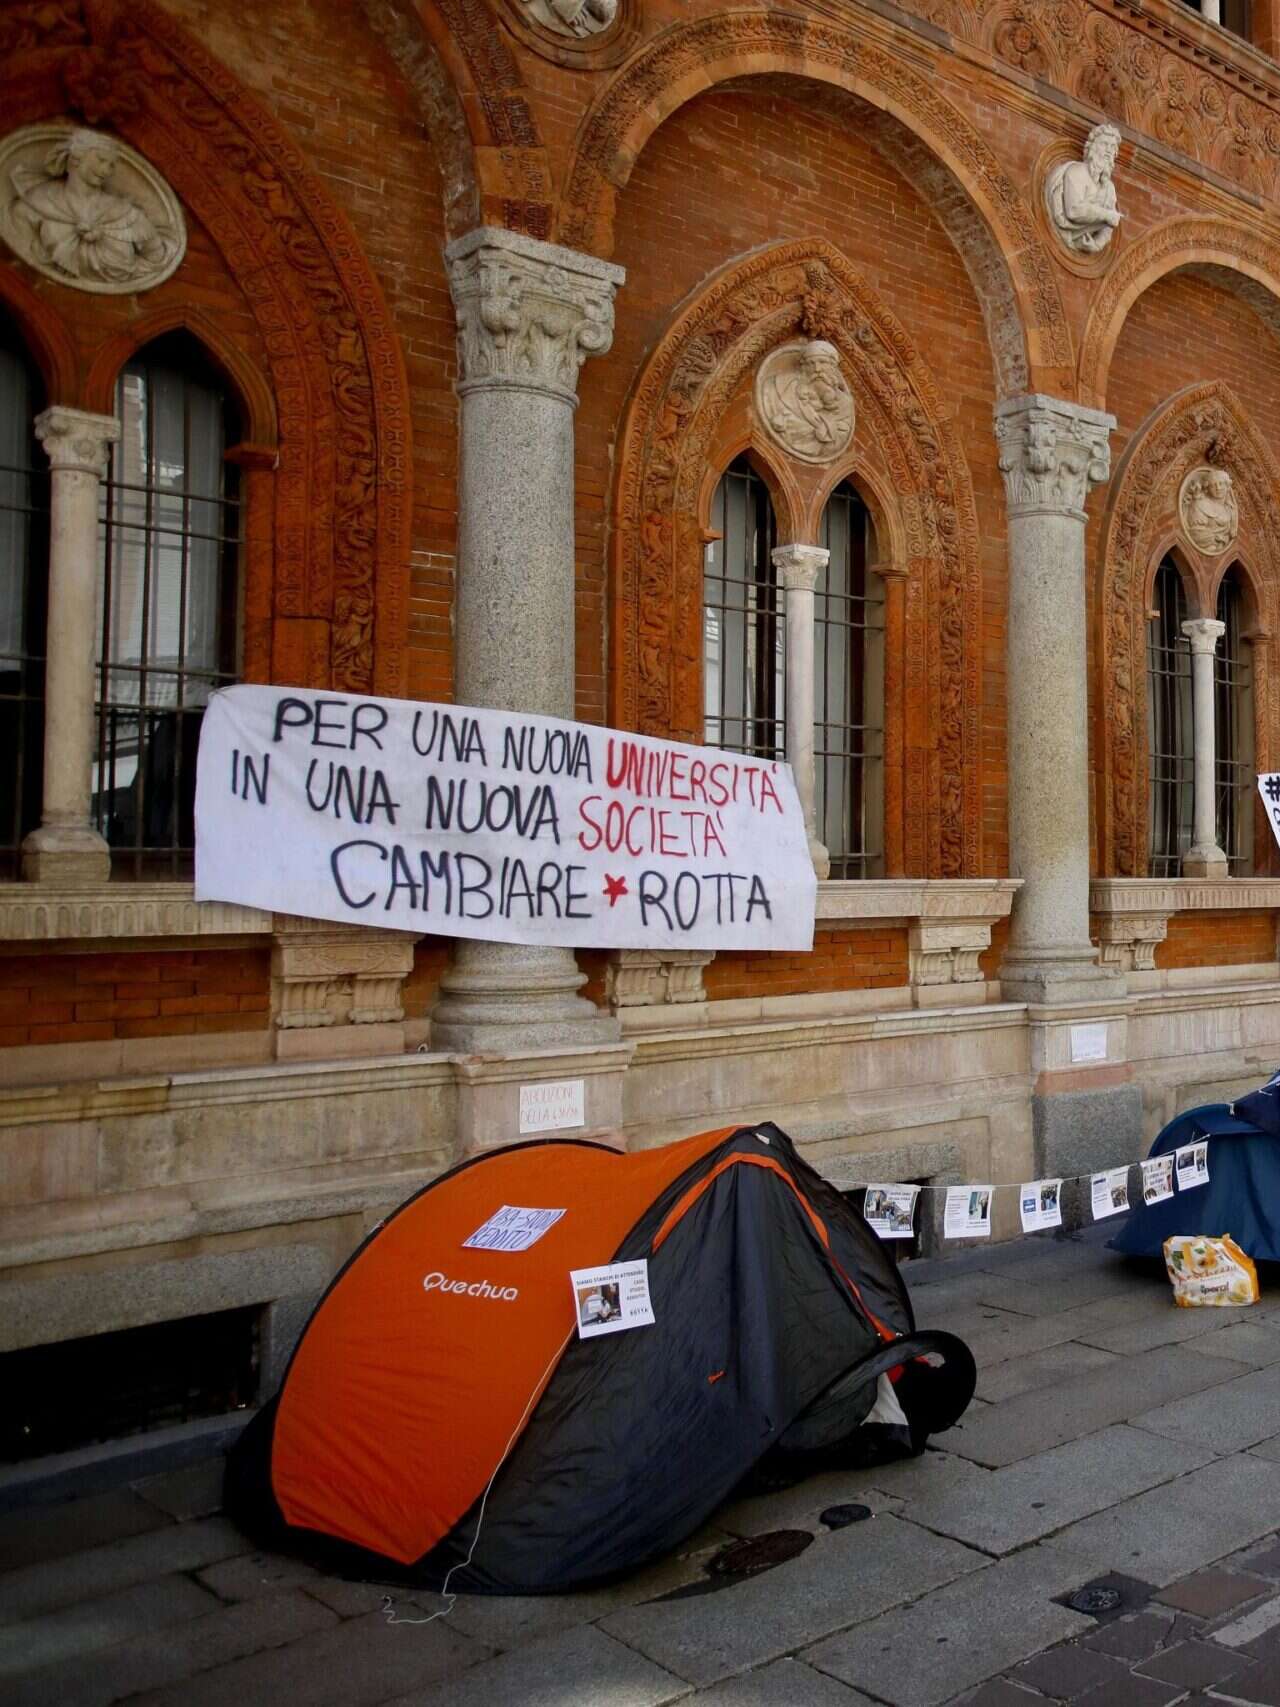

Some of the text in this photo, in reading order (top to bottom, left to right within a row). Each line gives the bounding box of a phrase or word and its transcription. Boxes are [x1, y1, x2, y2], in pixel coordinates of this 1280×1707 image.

[232, 749, 727, 857] IN UNA NUOVA SOCIETÀ
[273, 697, 784, 815] PER UNA NUOVA UNIVERSITÀ
[330, 840, 772, 931] CAMBIARE ROTTA
[423, 1272, 518, 1301] Quechua
